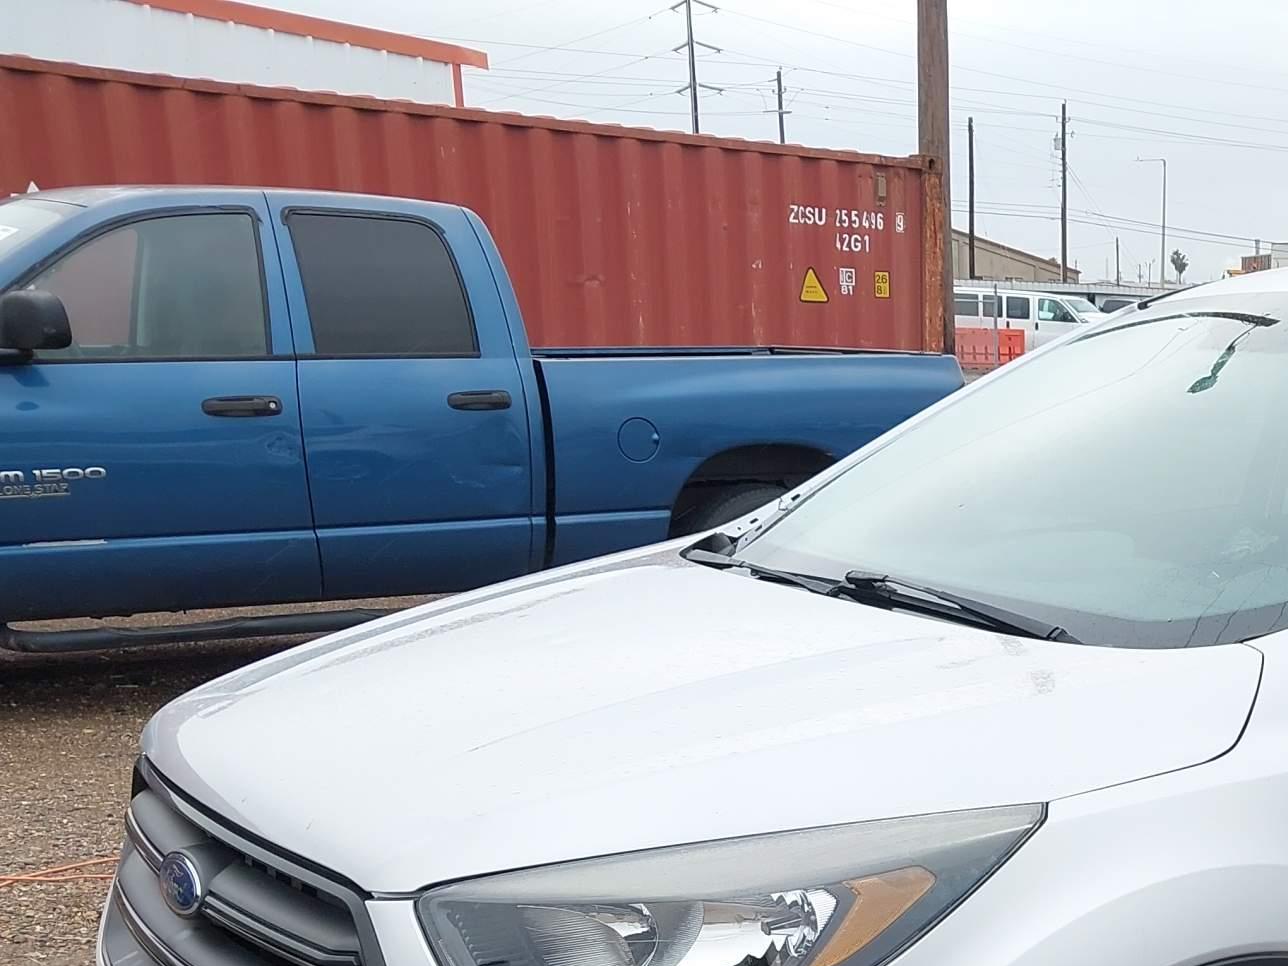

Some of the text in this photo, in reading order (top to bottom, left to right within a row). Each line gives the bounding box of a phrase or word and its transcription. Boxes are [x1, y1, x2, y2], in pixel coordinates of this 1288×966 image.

[789, 204, 826, 225] ZCSU
[835, 209, 885, 230] 255496
[836, 233, 870, 253] 42G1
[32, 466, 107, 481] 1500
[34, 482, 69, 495] STAR
